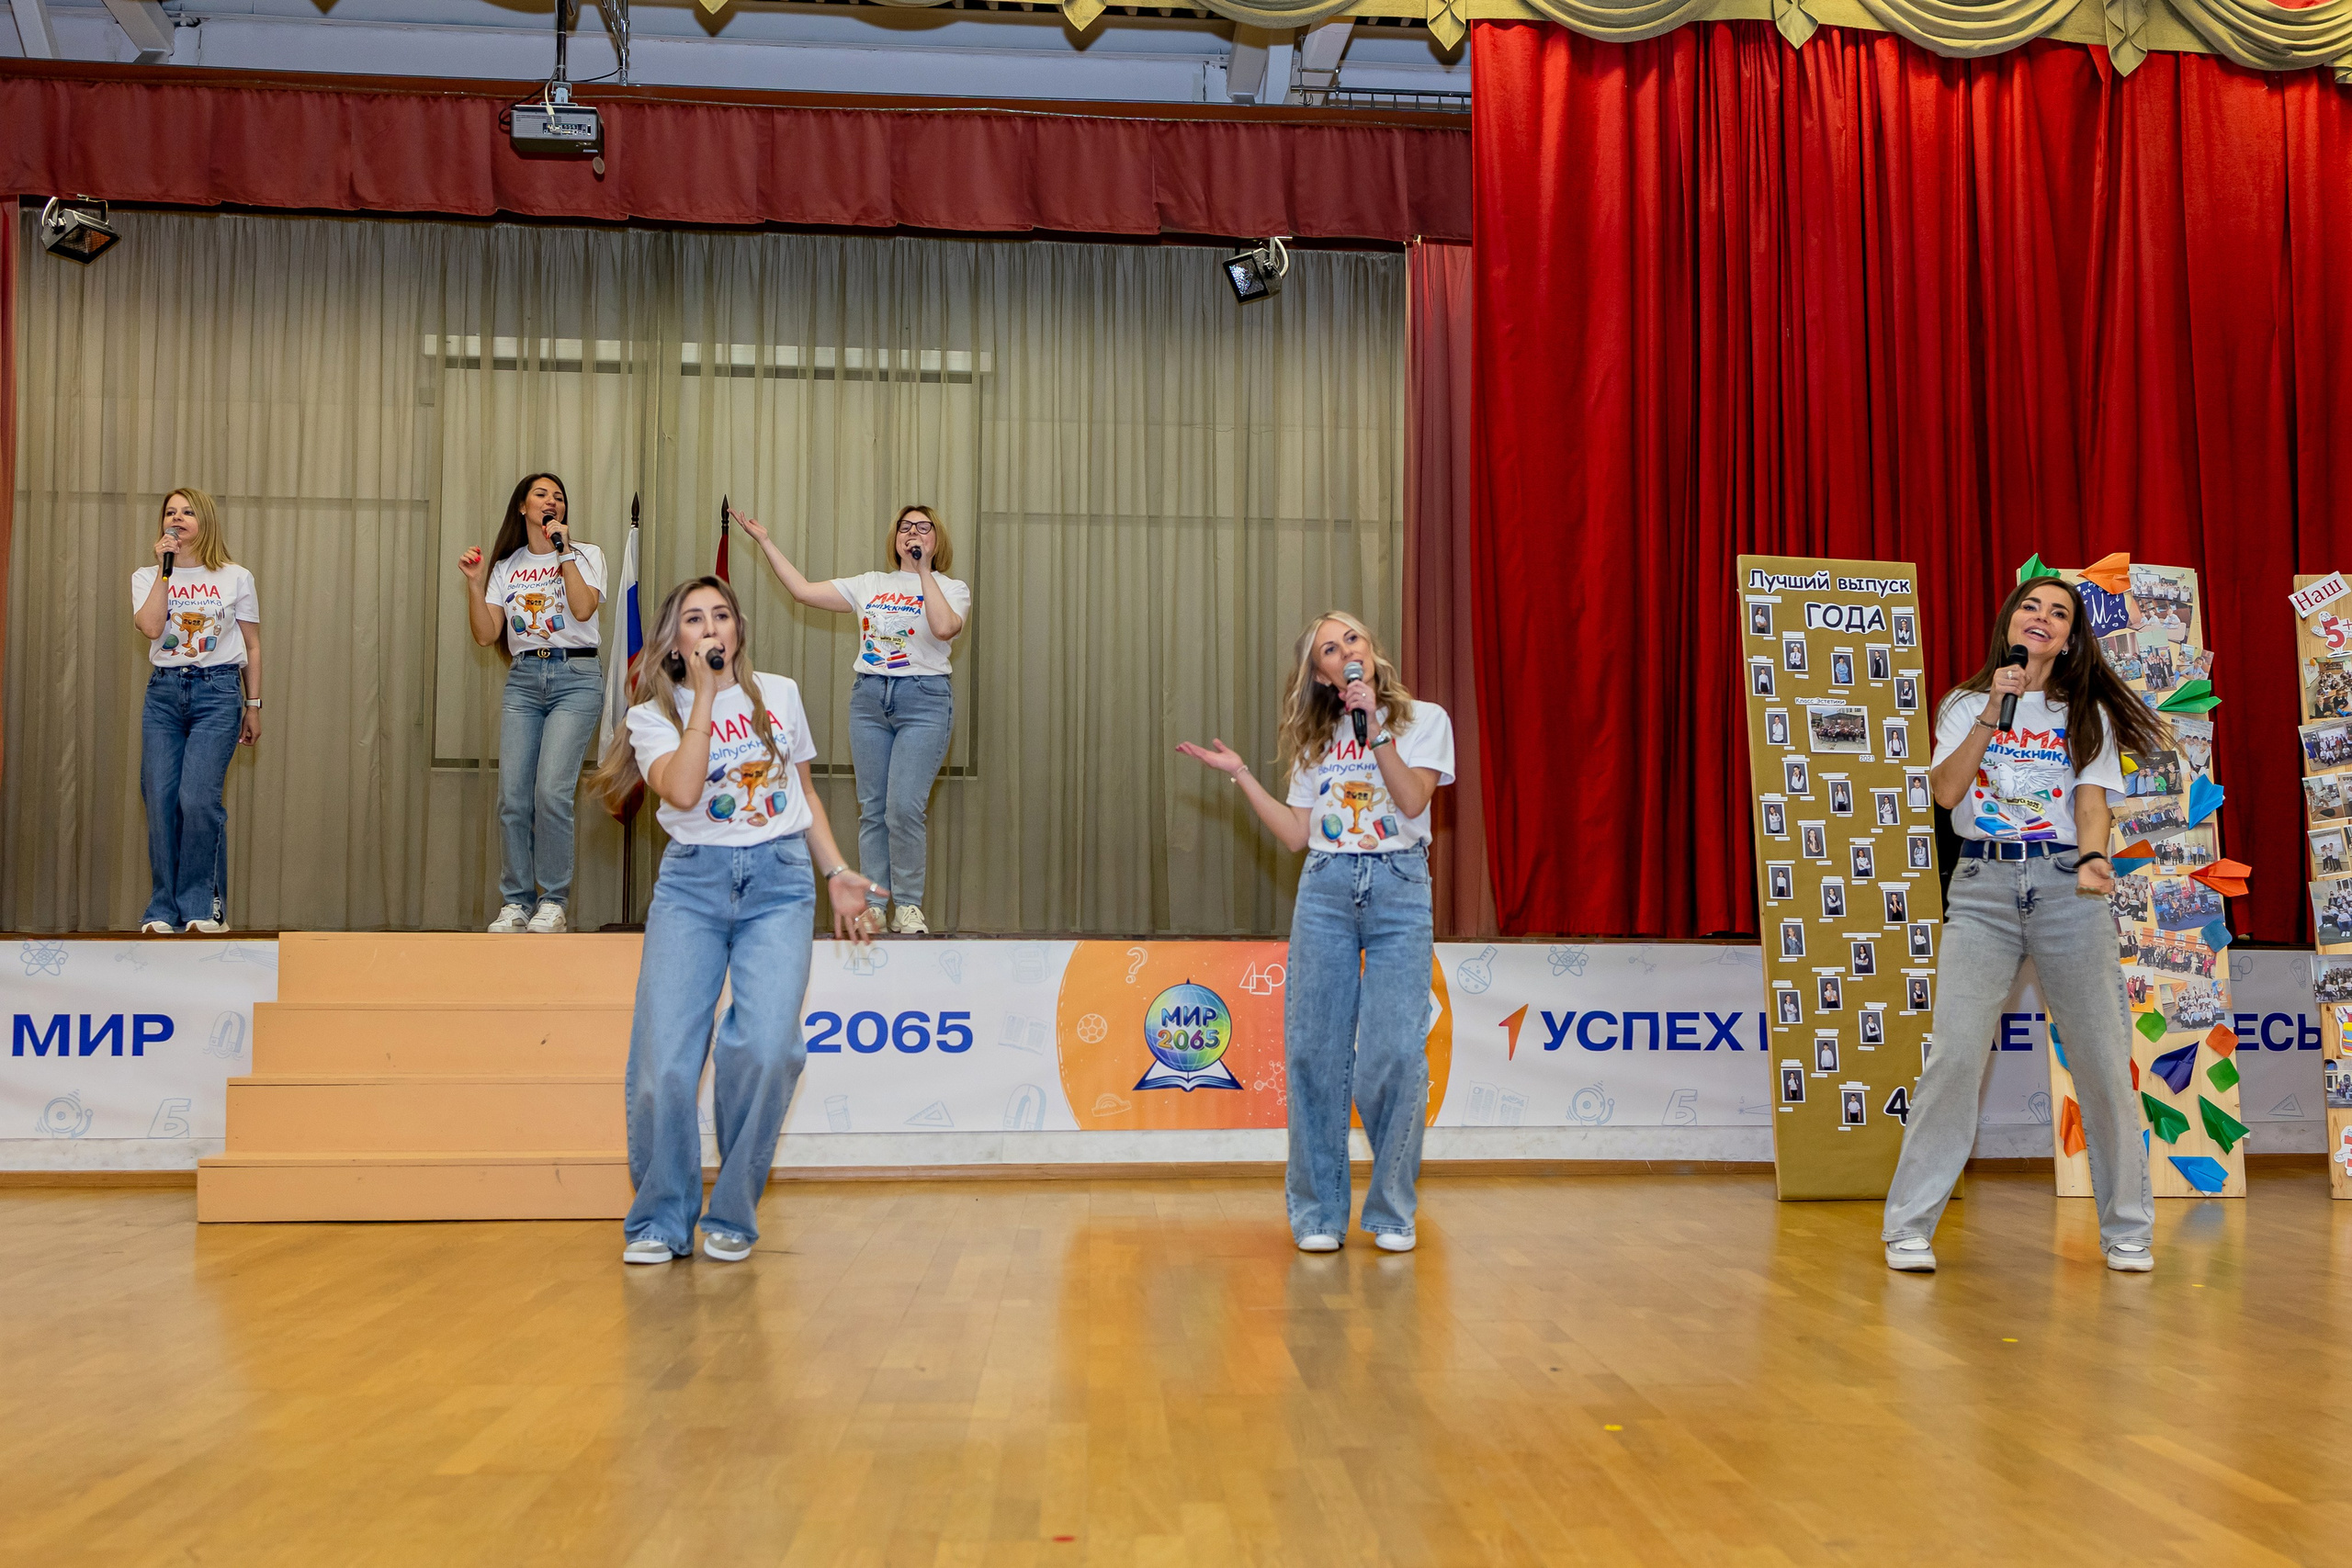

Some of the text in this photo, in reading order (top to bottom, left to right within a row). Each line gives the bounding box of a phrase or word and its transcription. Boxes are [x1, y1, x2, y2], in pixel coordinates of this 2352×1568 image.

[509, 566, 563, 583] МАМА
[1749, 570, 1910, 597] Лучший выпуск
[168, 599, 222, 608] пускника
[869, 592, 923, 608] МАМА
[2294, 579, 2343, 612] Наш
[1806, 603, 1885, 633] ГОДА
[1985, 743, 2072, 768] ЫПУСКНИКА
[1161, 1006, 1217, 1028] МИР
[12, 1013, 175, 1056] МИР
[805, 1010, 974, 1054] 2065
[1158, 1030, 1220, 1051] 2065
[1540, 1010, 1746, 1052] УСПЕХ
[2233, 1012, 2323, 1052] ЕСЬ
